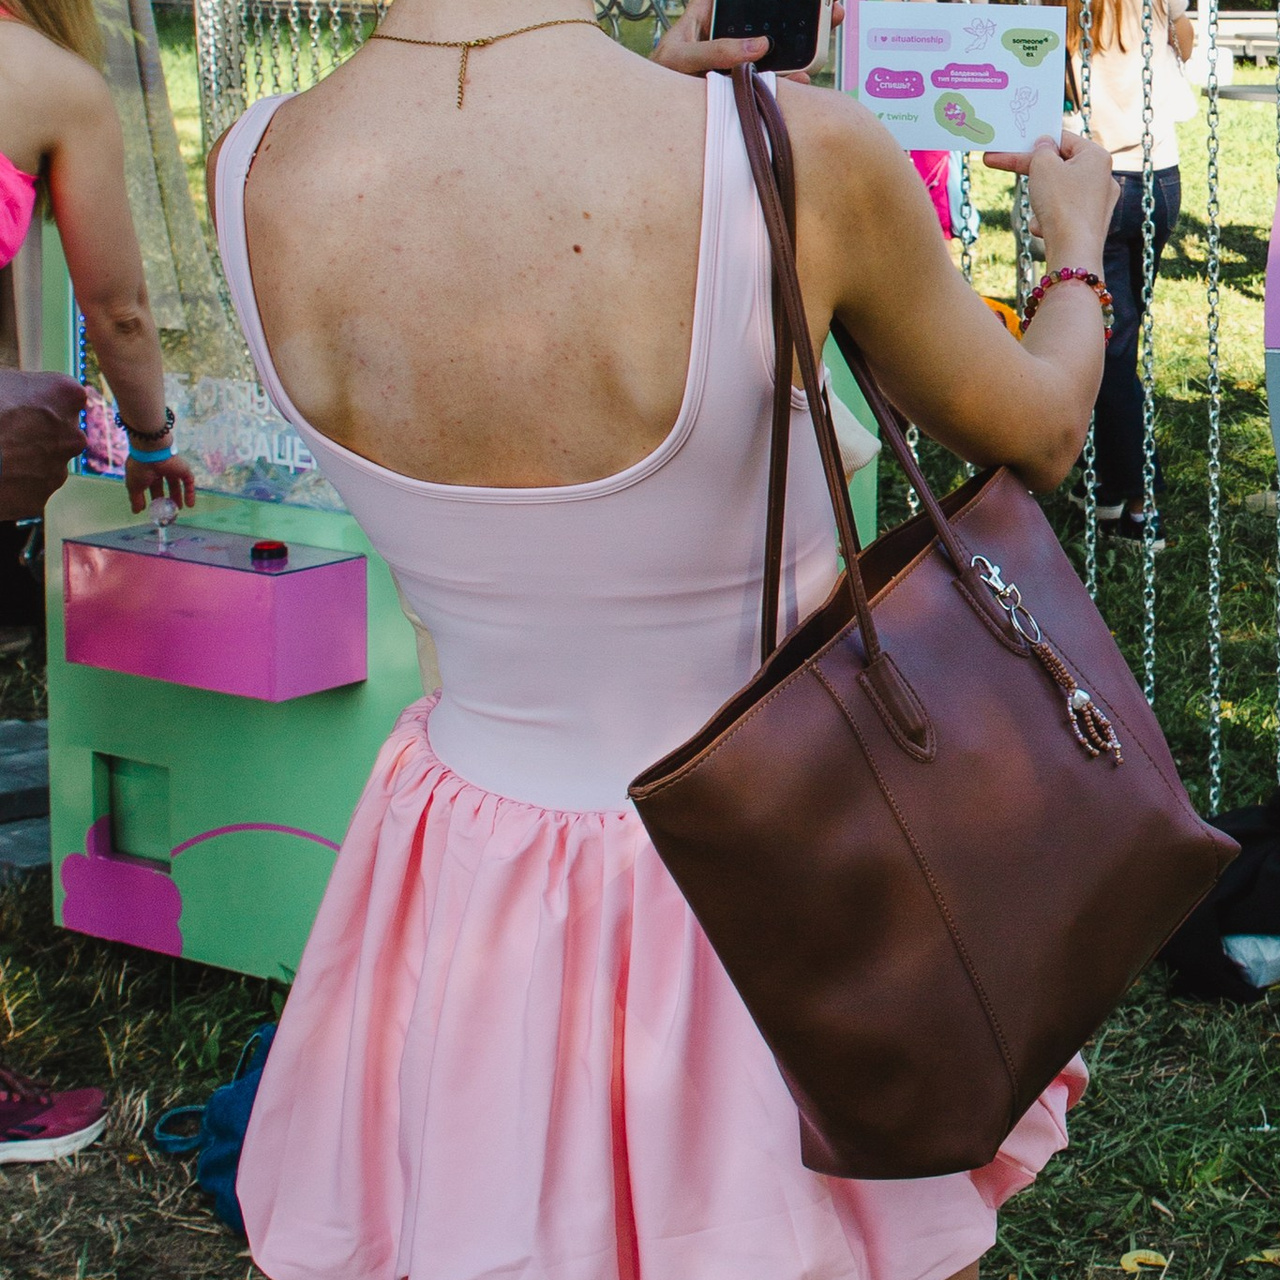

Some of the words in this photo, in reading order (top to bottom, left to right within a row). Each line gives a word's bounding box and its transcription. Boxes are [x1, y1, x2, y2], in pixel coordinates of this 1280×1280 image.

[891, 34, 944, 44] situationship
[887, 112, 918, 122] twinby
[236, 431, 318, 474] ЗАЦЕ
